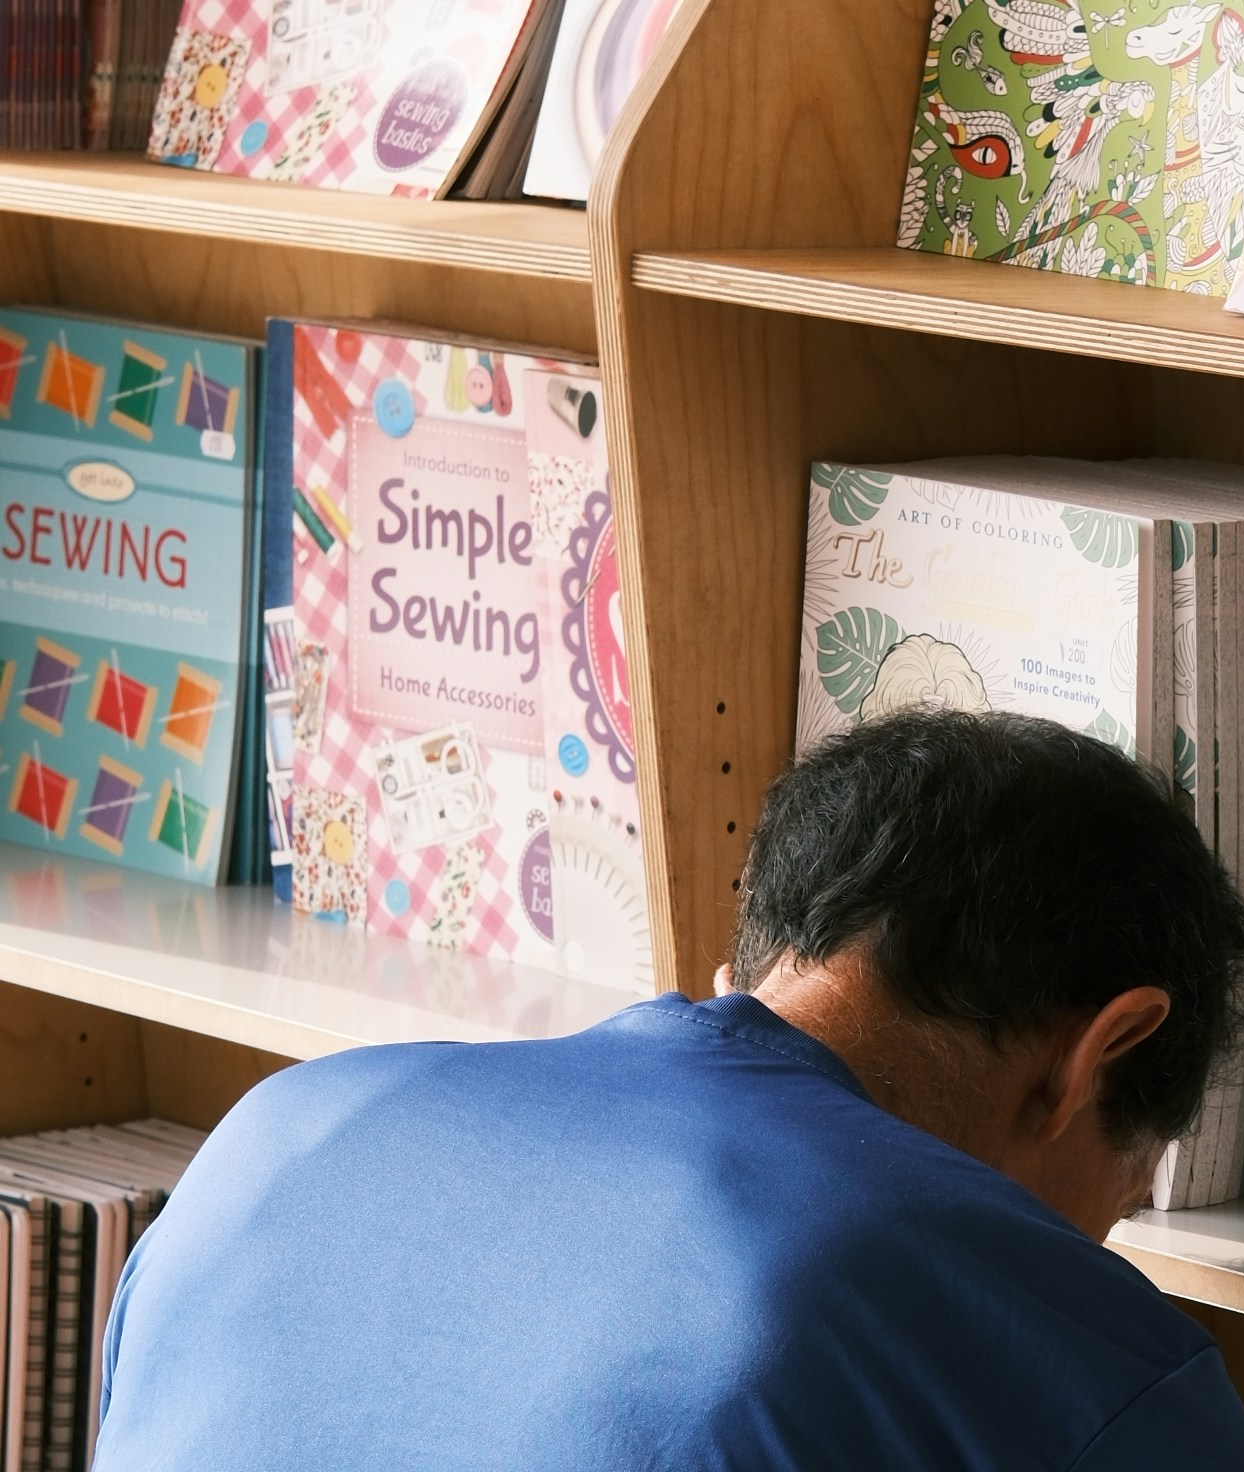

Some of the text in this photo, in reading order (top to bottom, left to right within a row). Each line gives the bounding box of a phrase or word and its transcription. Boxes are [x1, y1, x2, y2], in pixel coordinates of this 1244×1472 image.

[394, 99, 451, 133] sewing
[381, 119, 432, 154] basics
[404, 450, 510, 483] Introduction to
[2, 502, 187, 589] SEWING
[378, 477, 533, 580] Simple
[897, 509, 1064, 549] ART OF COLORING
[833, 528, 914, 589] The
[370, 567, 540, 684] Sewing
[1072, 638, 1088, 647] UNIT
[1020, 658, 1096, 686] 100 Images to
[1068, 648, 1086, 665] 200
[380, 666, 536, 717] Home Accessories
[1013, 677, 1101, 709] Inspire Creativity
